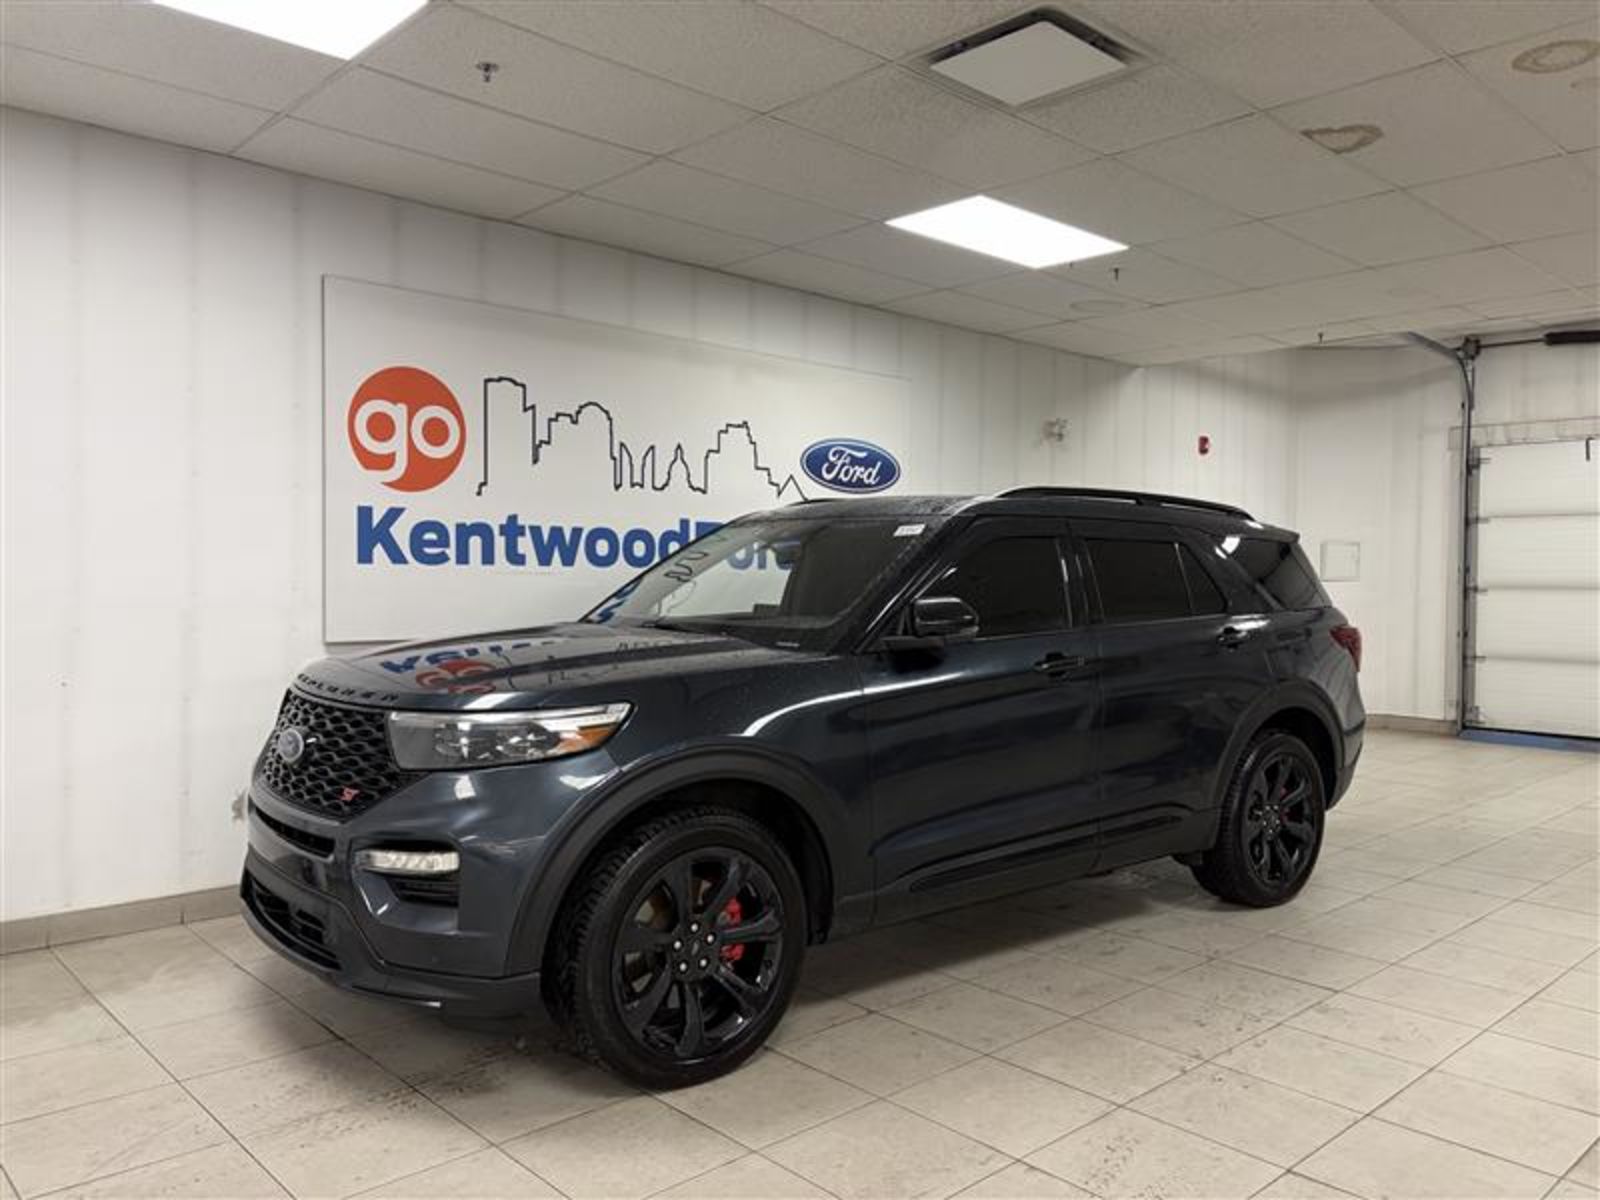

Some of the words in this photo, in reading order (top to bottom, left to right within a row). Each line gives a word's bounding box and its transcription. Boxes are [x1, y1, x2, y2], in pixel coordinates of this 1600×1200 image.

[353, 399, 460, 483] go
[821, 446, 882, 485] Ford
[356, 504, 797, 571] Kentwoodor
